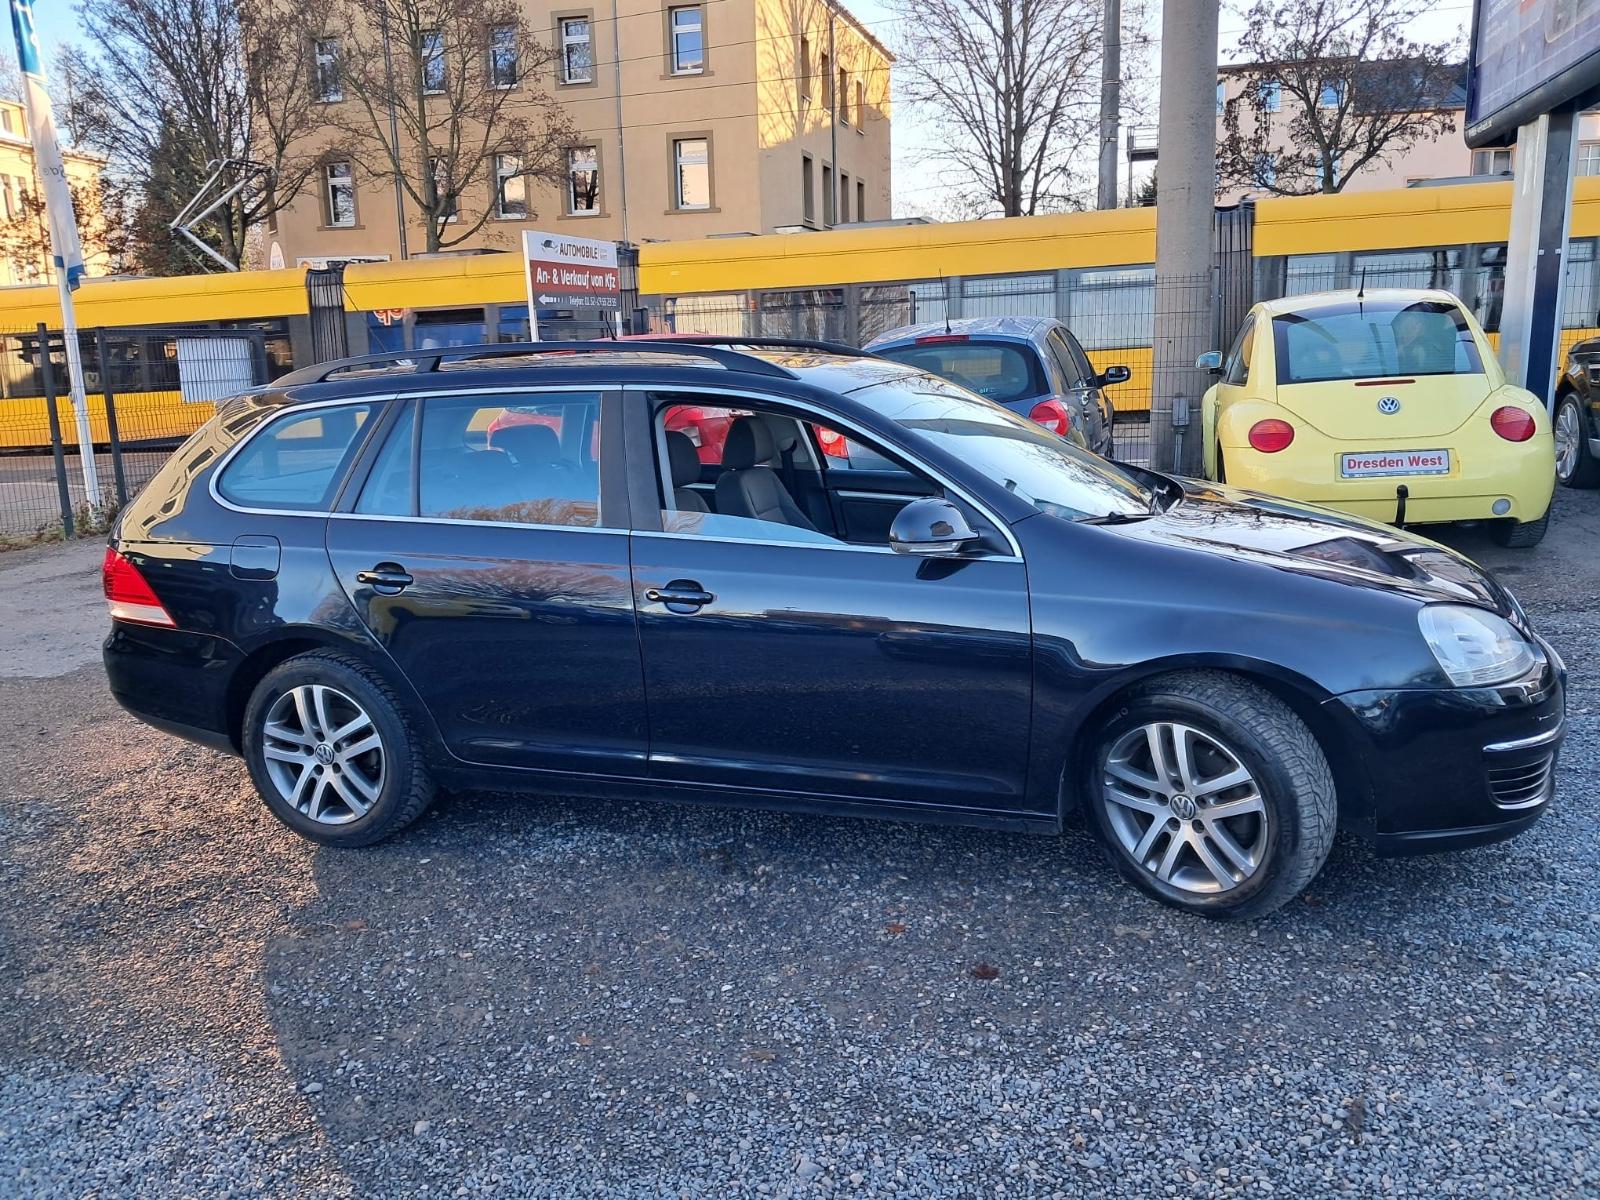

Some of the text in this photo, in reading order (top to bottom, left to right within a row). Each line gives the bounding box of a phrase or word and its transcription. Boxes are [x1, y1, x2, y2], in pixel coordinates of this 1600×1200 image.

[559, 243, 598, 260] AUTOMOBILE
[536, 267, 616, 291] An- & Verkauf von Kfz
[1378, 397, 1400, 414] VW
[1347, 455, 1443, 470] Dresden West
